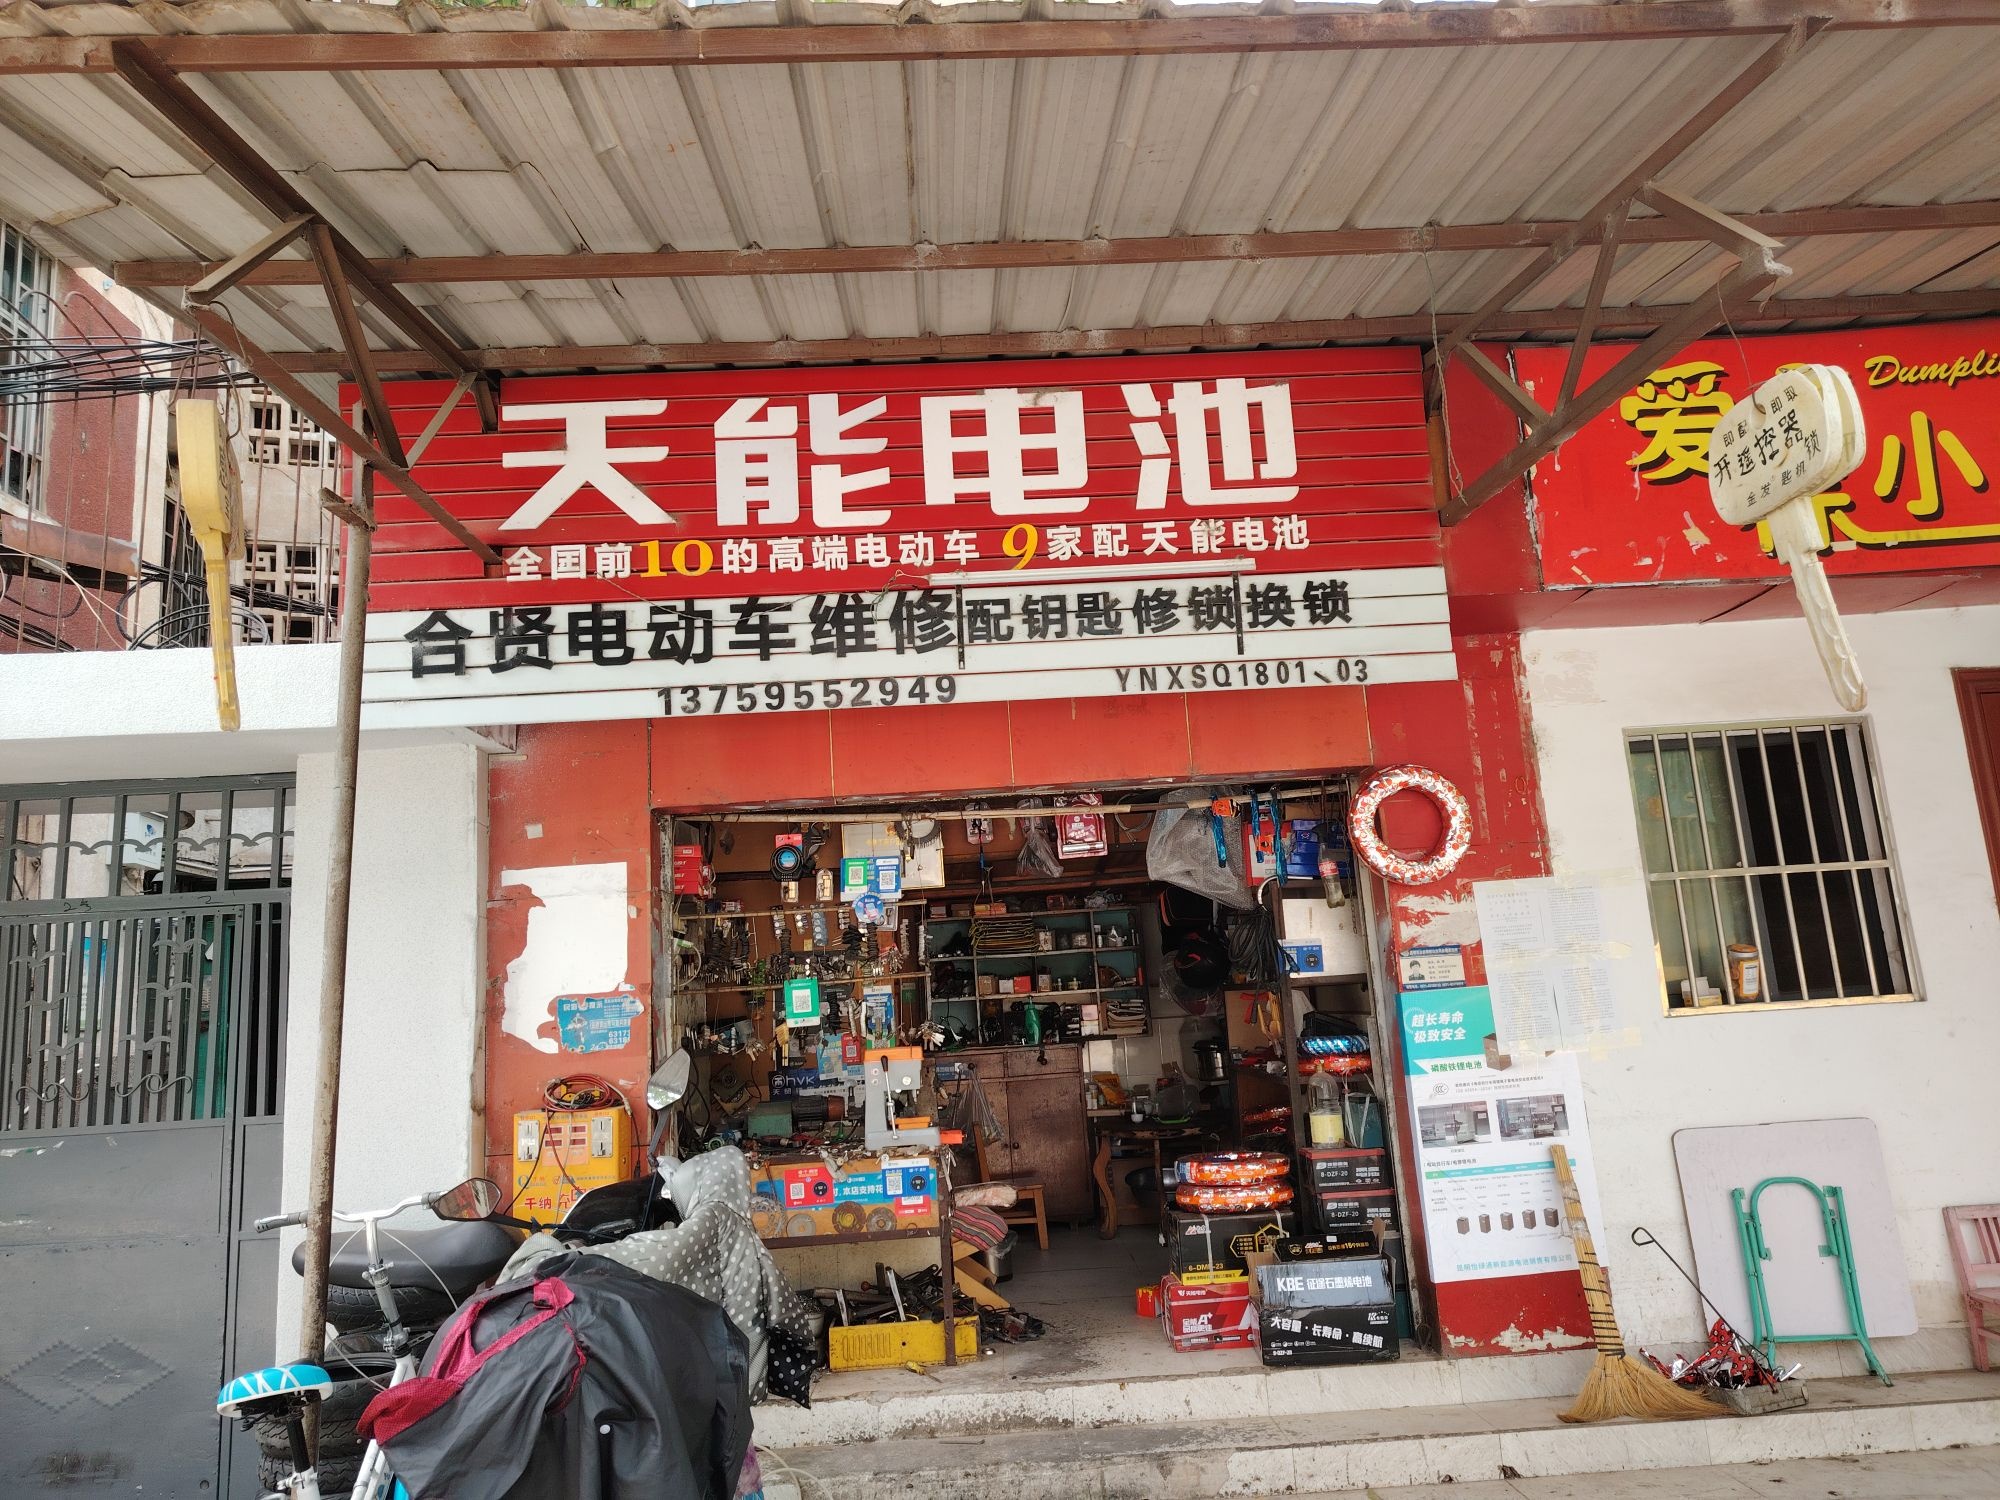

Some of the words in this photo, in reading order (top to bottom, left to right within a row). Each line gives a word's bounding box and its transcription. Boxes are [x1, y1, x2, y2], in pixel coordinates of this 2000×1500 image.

[1864, 348, 2000, 388] Dumpli
[498, 377, 1299, 531] 天能电池
[657, 675, 957, 716] 13759552949
[1411, 1010, 1464, 1028] 超长寿命
[1414, 1027, 1466, 1044] 极致安全
[1431, 1061, 1483, 1073] 磷酸铁锂电池
[525, 1197, 552, 1210] 千纳
